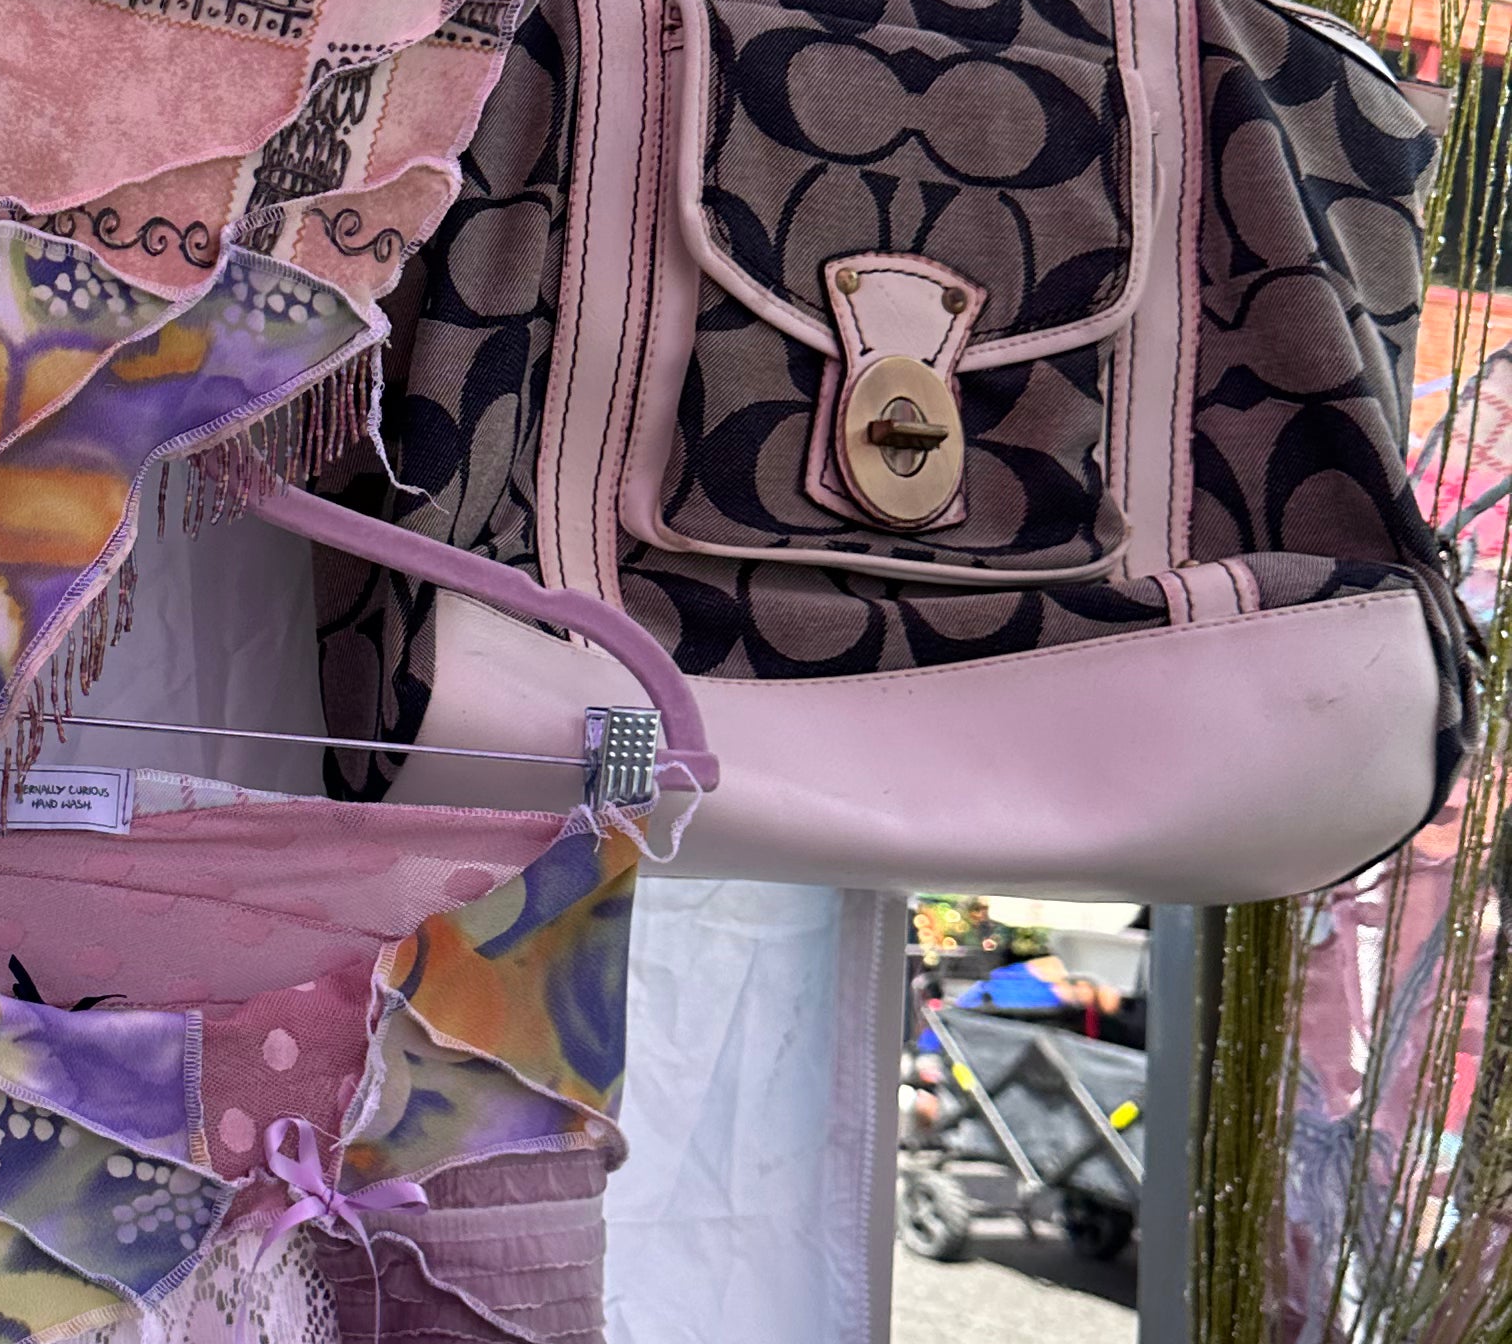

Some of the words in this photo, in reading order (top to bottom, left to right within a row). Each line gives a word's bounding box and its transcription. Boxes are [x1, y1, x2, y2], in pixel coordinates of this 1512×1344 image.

[15, 784, 66, 795] ERNALLY
[68, 784, 110, 798] CURIOUS
[31, 798, 58, 809] HAND
